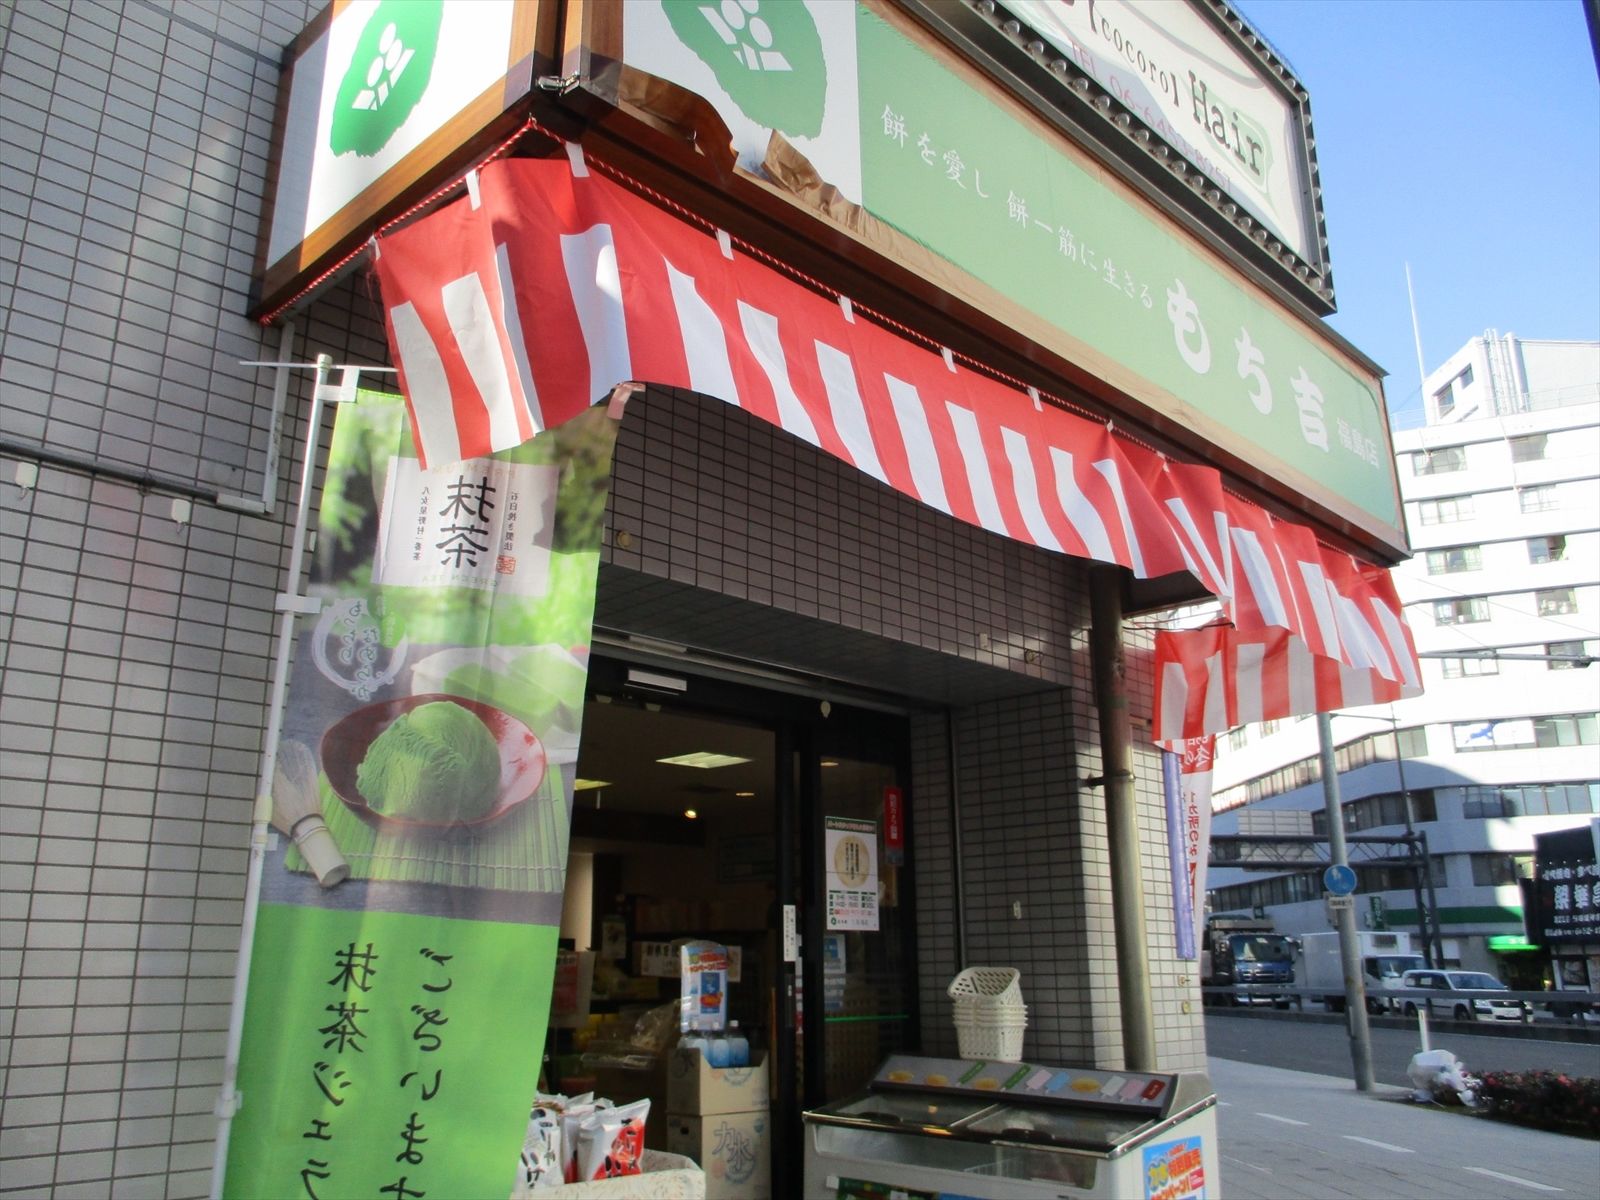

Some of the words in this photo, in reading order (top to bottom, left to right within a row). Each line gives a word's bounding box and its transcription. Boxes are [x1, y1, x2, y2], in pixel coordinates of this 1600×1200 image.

[880, 104, 989, 199] 餅を愛し
[1006, 190, 1153, 309] 餅一筋に生きる
[1187, 69, 1263, 177] Hair
[1166, 277, 1330, 454] もち吉
